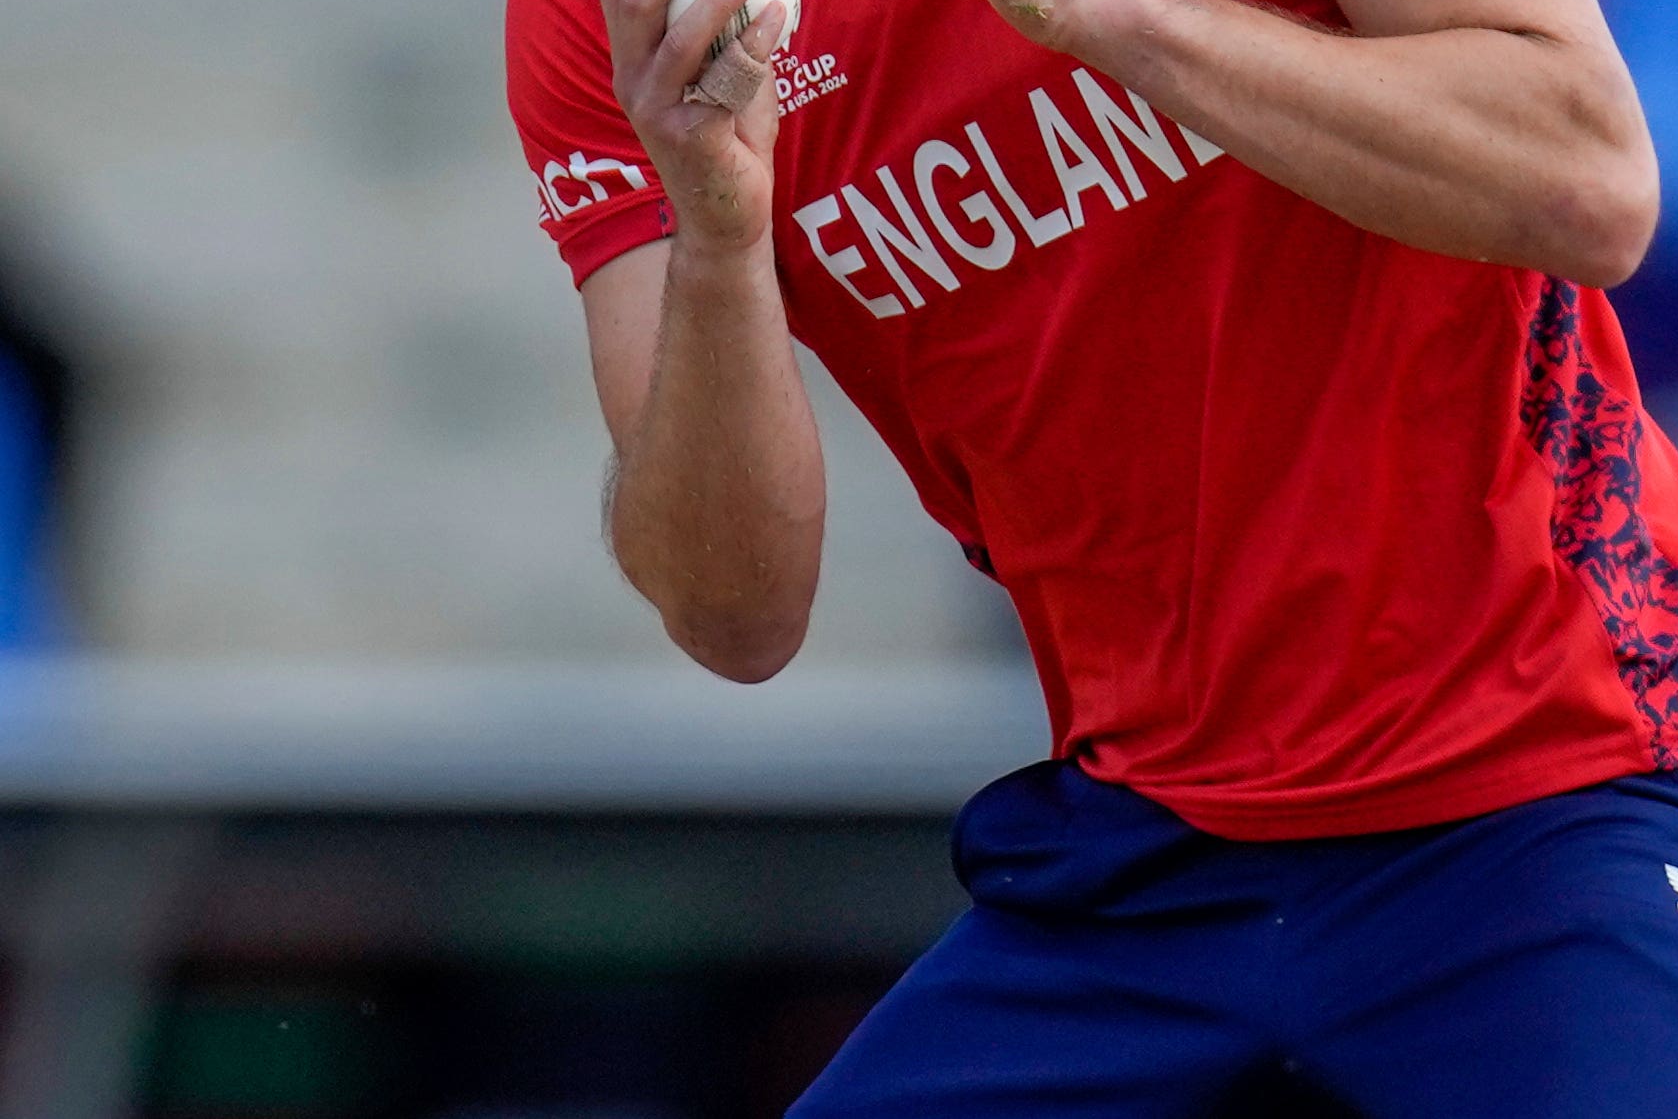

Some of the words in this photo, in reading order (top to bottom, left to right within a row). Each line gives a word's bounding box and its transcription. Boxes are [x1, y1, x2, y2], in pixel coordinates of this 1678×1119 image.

[776, 55, 799, 73] T20
[794, 53, 837, 88] CUP
[818, 72, 848, 94] 2024
[793, 67, 1226, 319] ENGLAN
